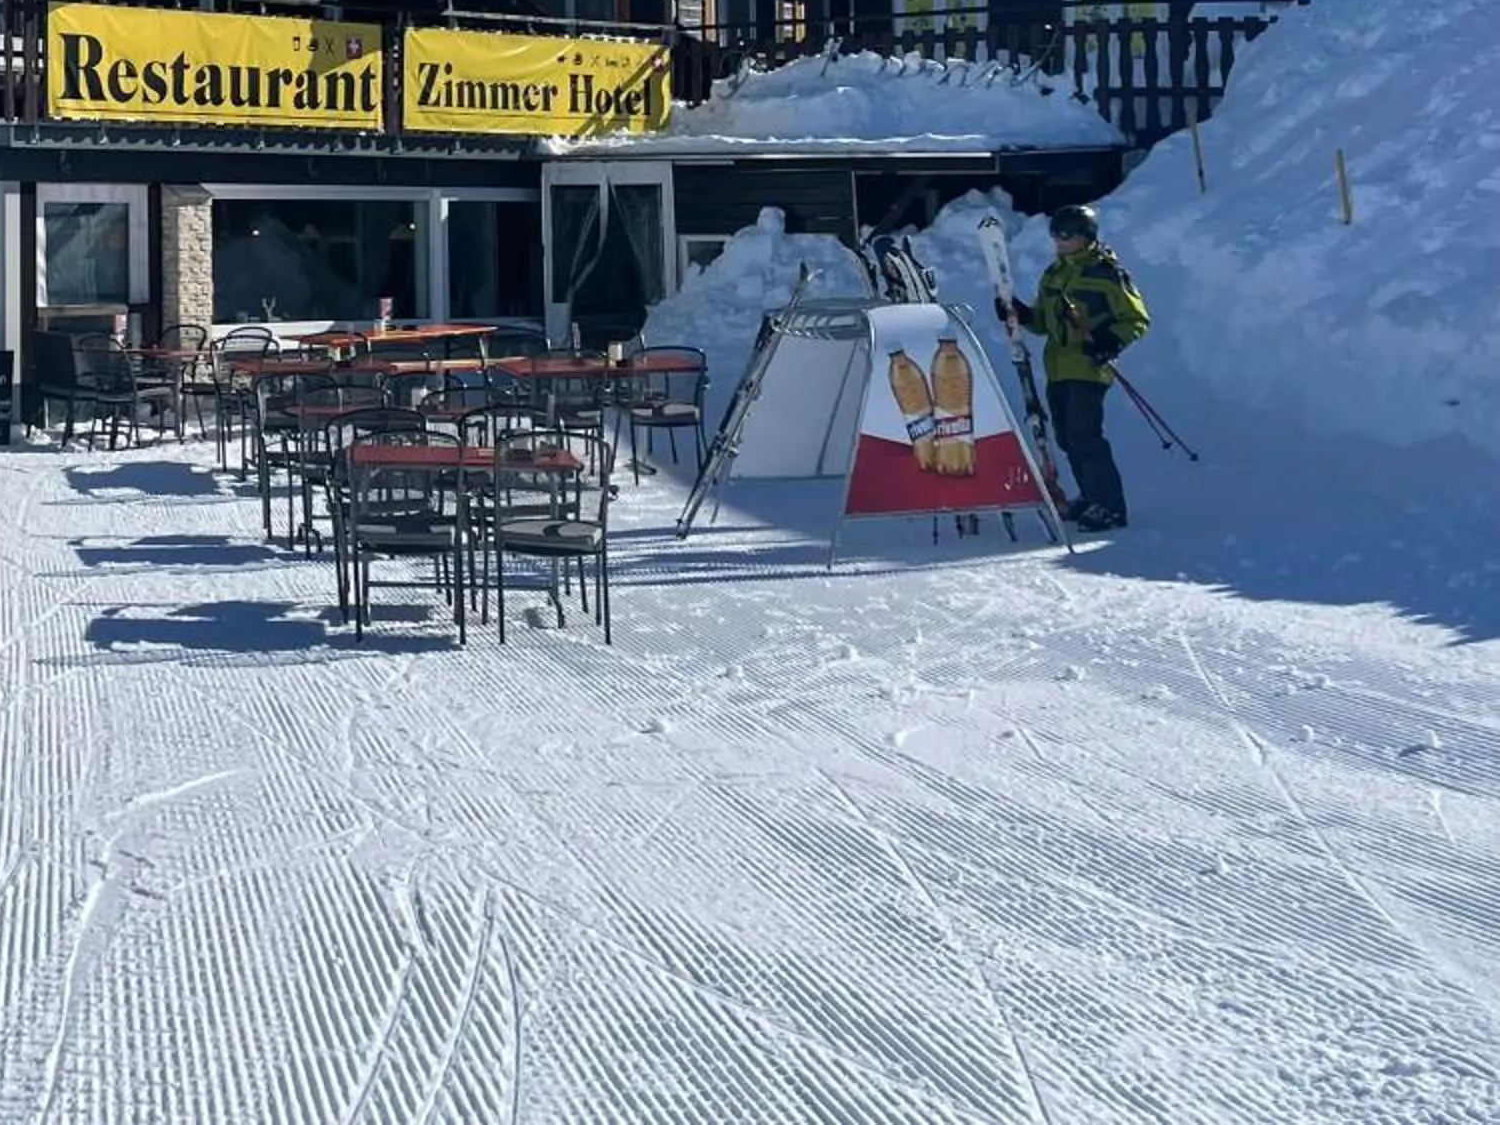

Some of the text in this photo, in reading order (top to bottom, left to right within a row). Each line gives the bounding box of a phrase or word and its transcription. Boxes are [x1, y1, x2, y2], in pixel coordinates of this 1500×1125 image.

[57, 31, 379, 114] Restaurant
[417, 61, 652, 117] Zimmer Hotel
